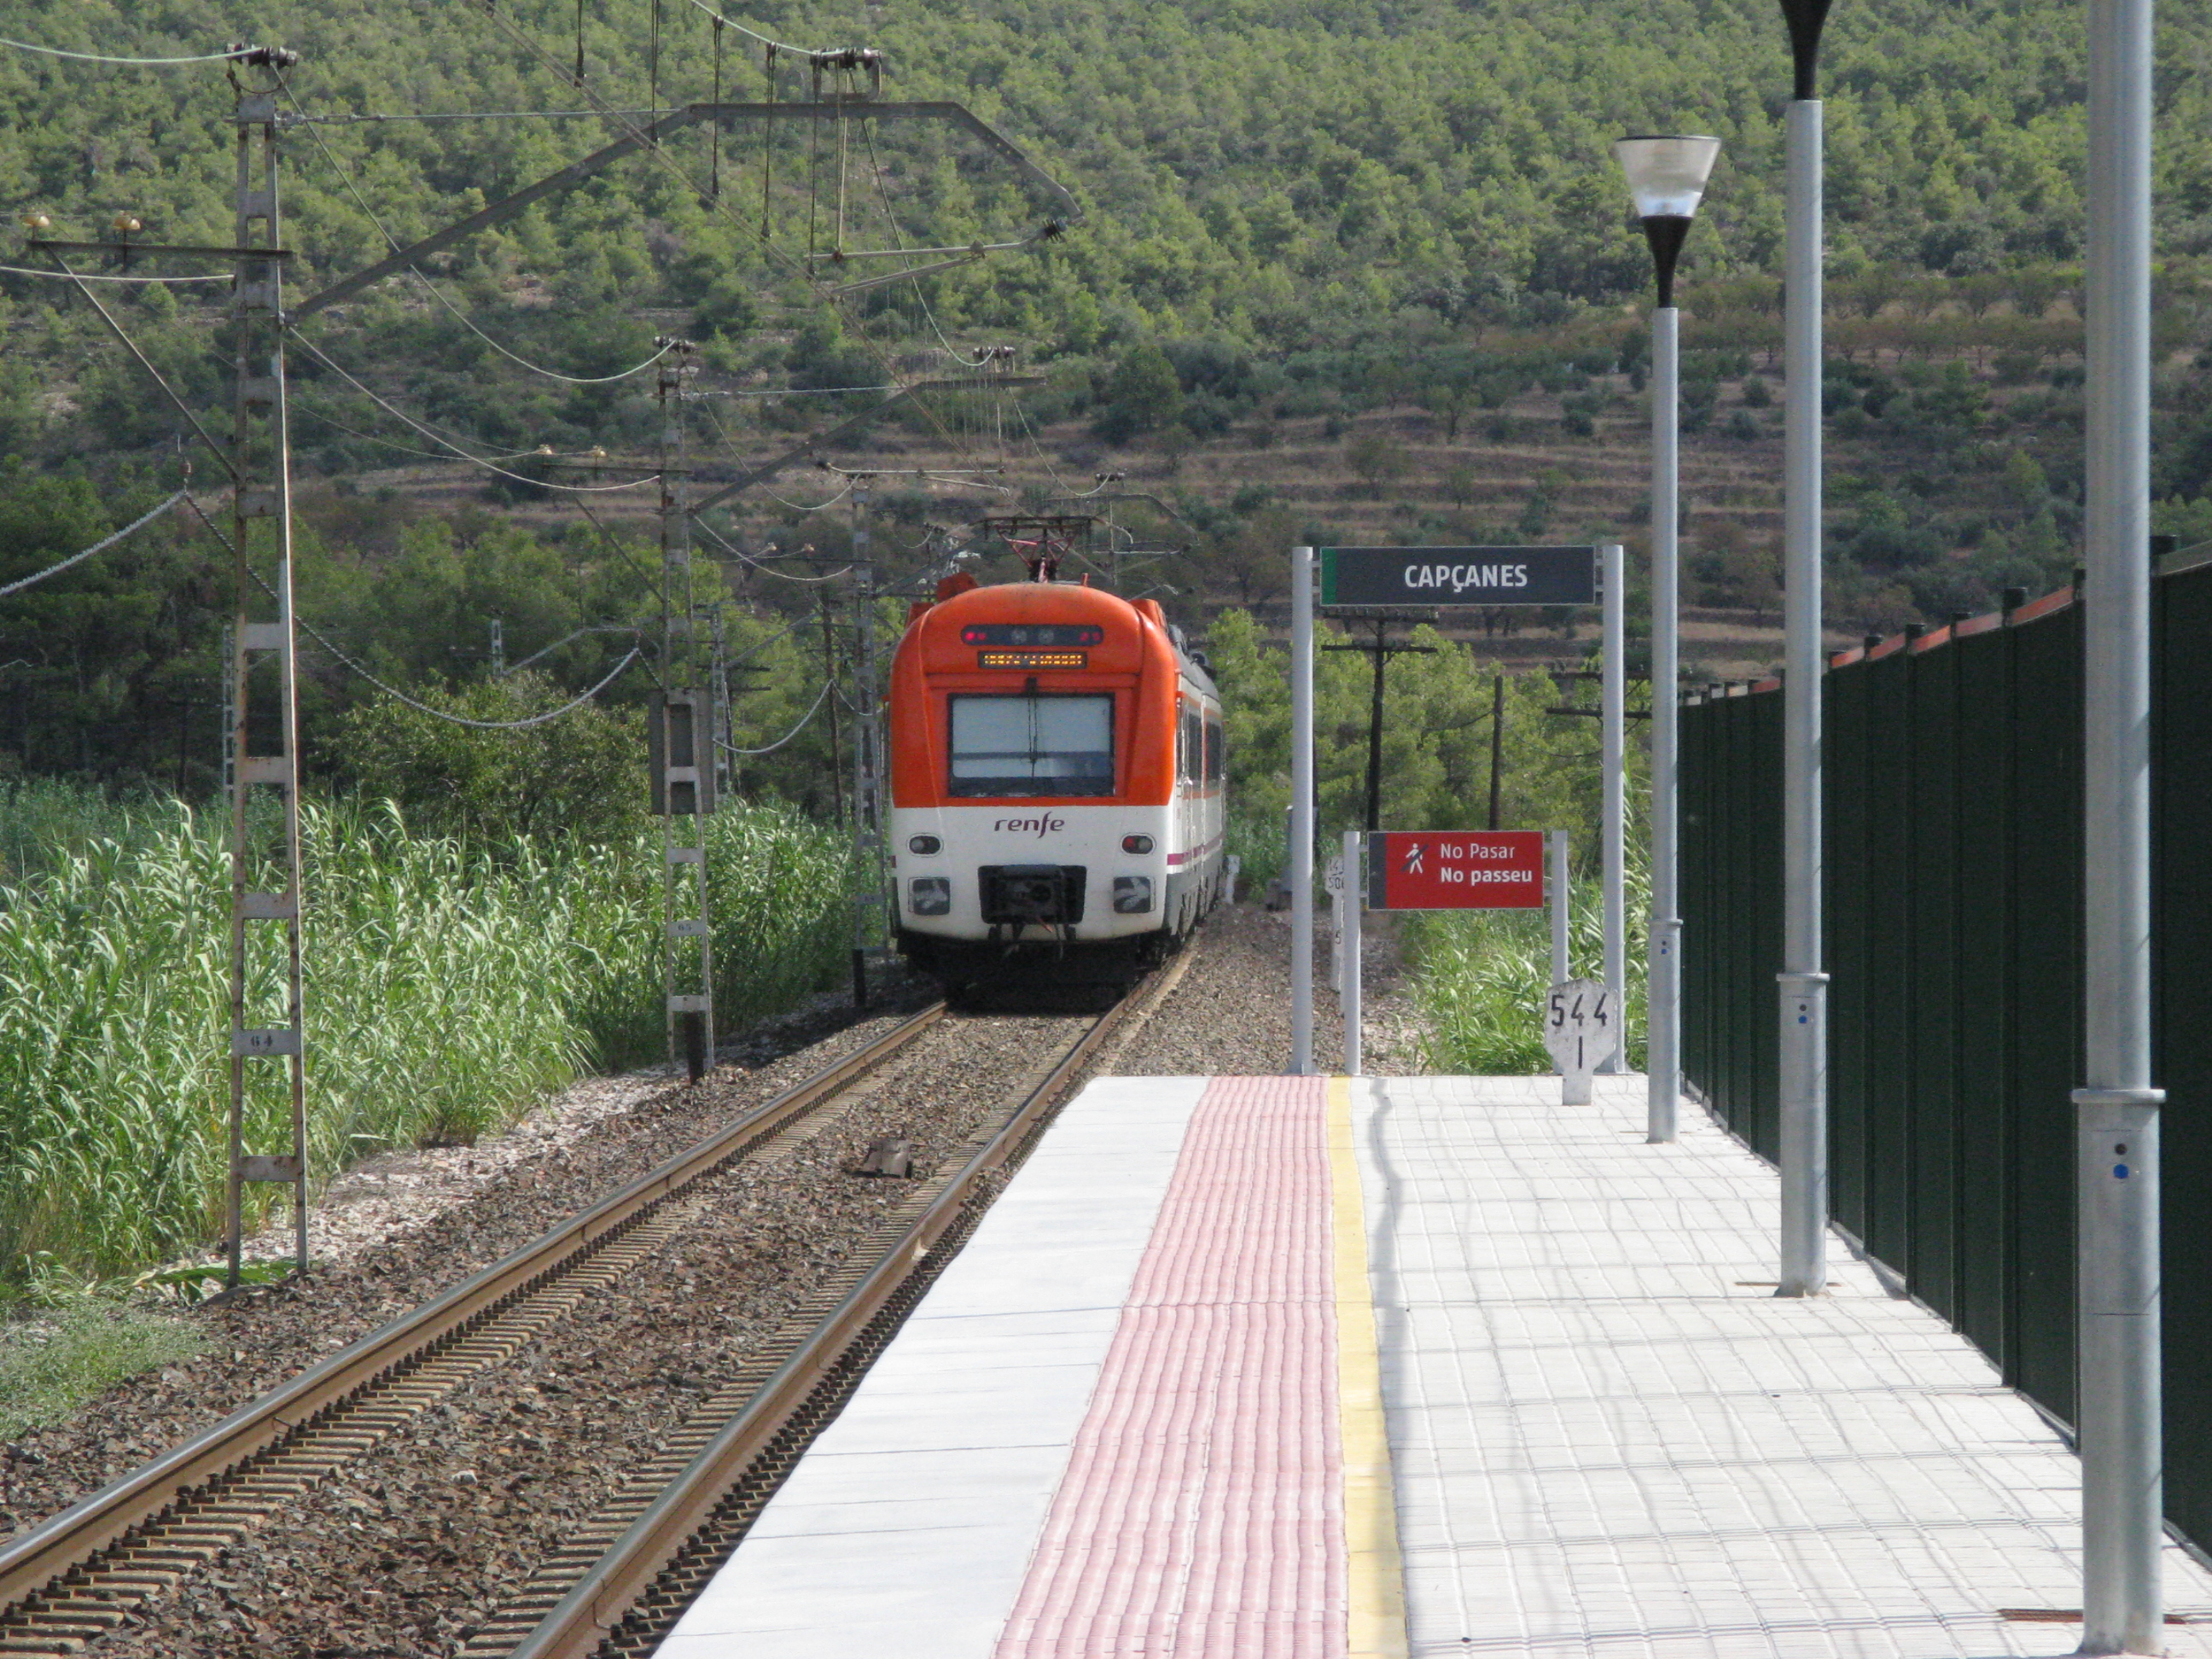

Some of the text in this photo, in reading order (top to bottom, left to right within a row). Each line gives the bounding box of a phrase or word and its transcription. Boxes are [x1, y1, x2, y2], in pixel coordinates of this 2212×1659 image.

[1405, 564, 1528, 593] CAPÇANES
[994, 811, 1065, 840] renfe
[1441, 843, 1515, 859] No Pasar
[1441, 867, 1533, 887] No passeu
[1551, 992, 1608, 1027] 544
